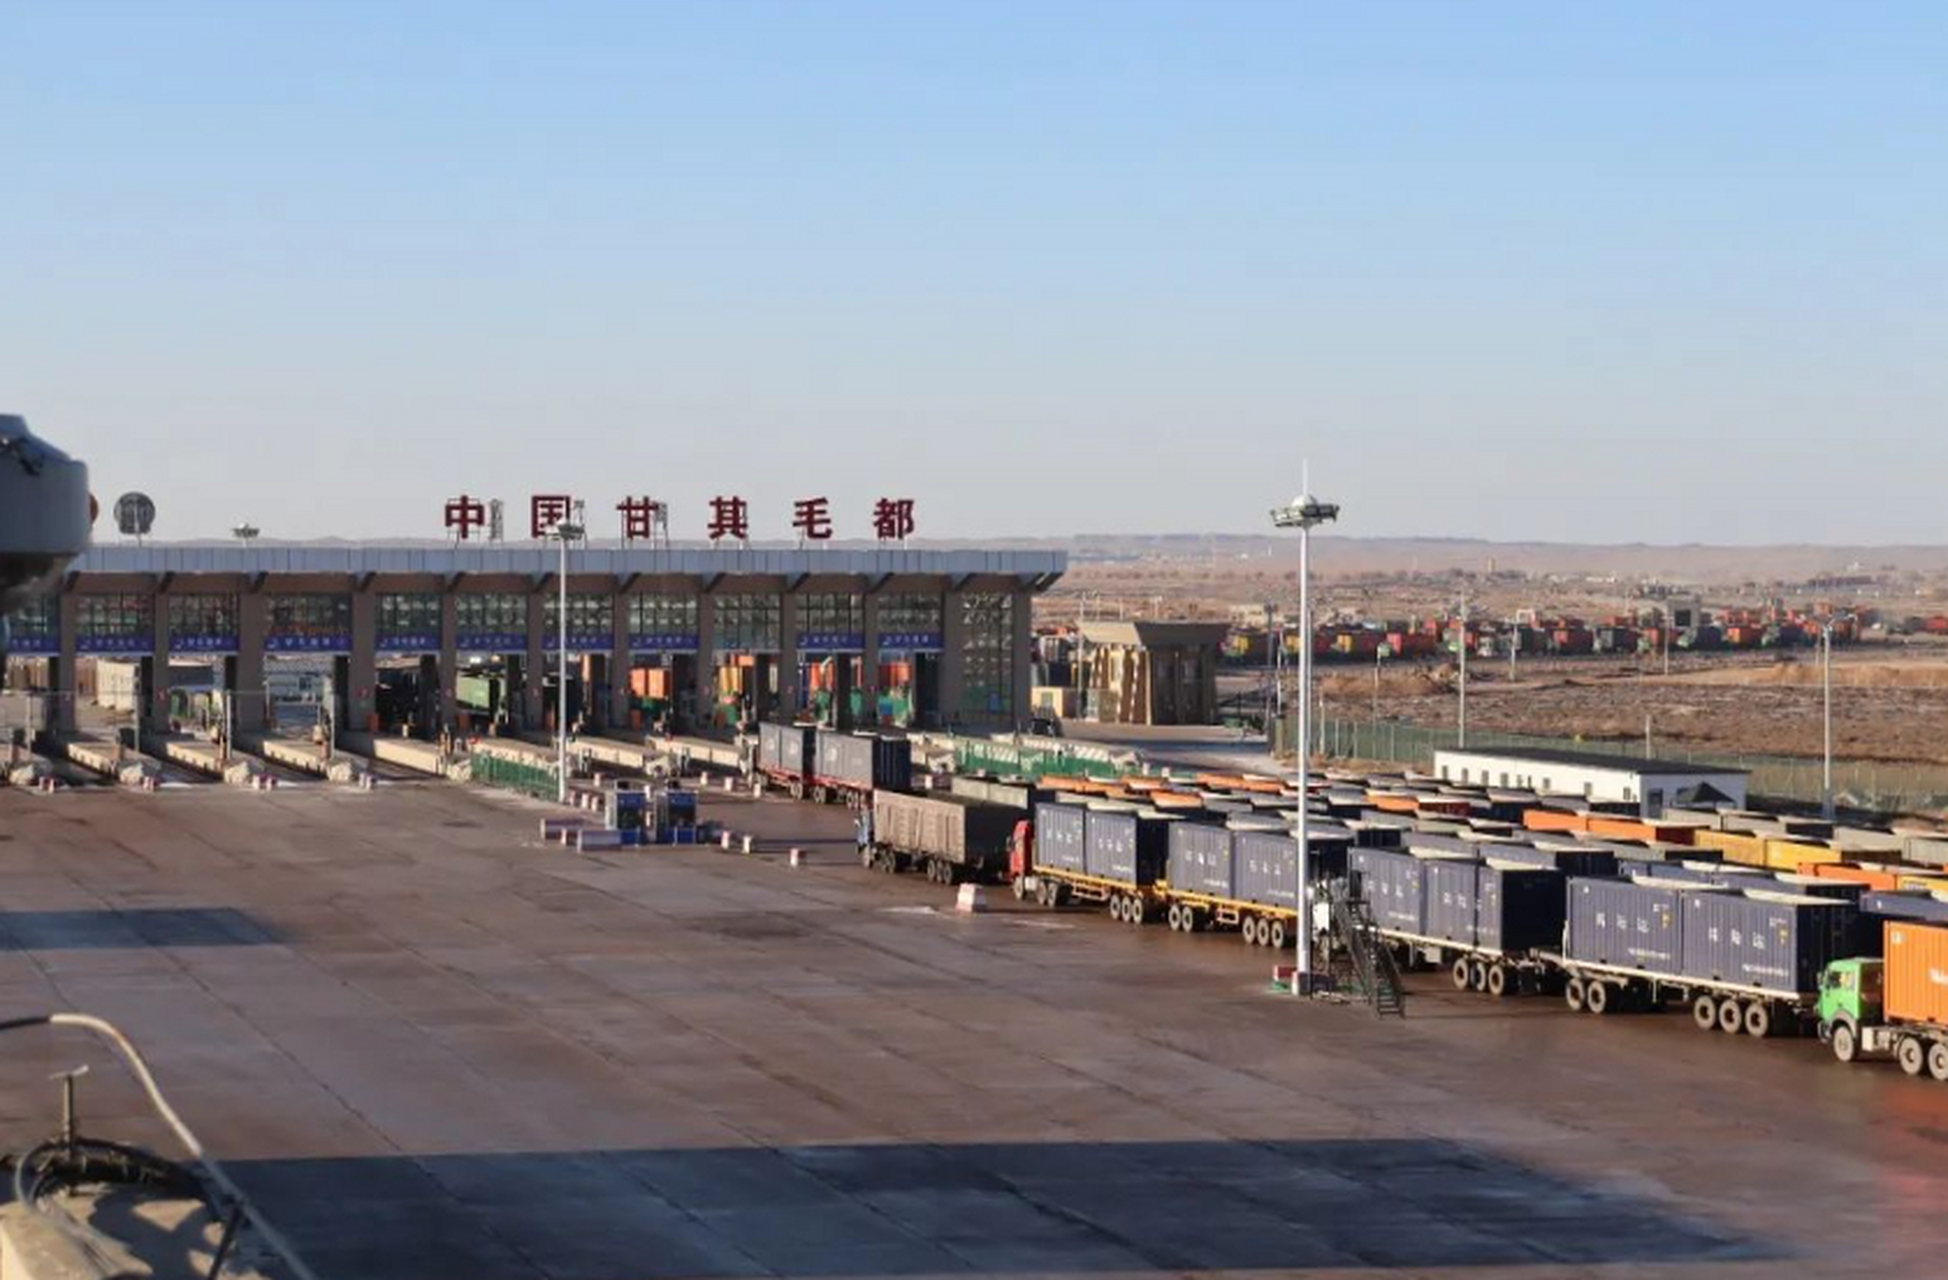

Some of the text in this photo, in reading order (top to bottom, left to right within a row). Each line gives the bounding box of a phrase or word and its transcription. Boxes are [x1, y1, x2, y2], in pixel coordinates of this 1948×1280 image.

[445, 495, 915, 540] 中国甘其毛都
